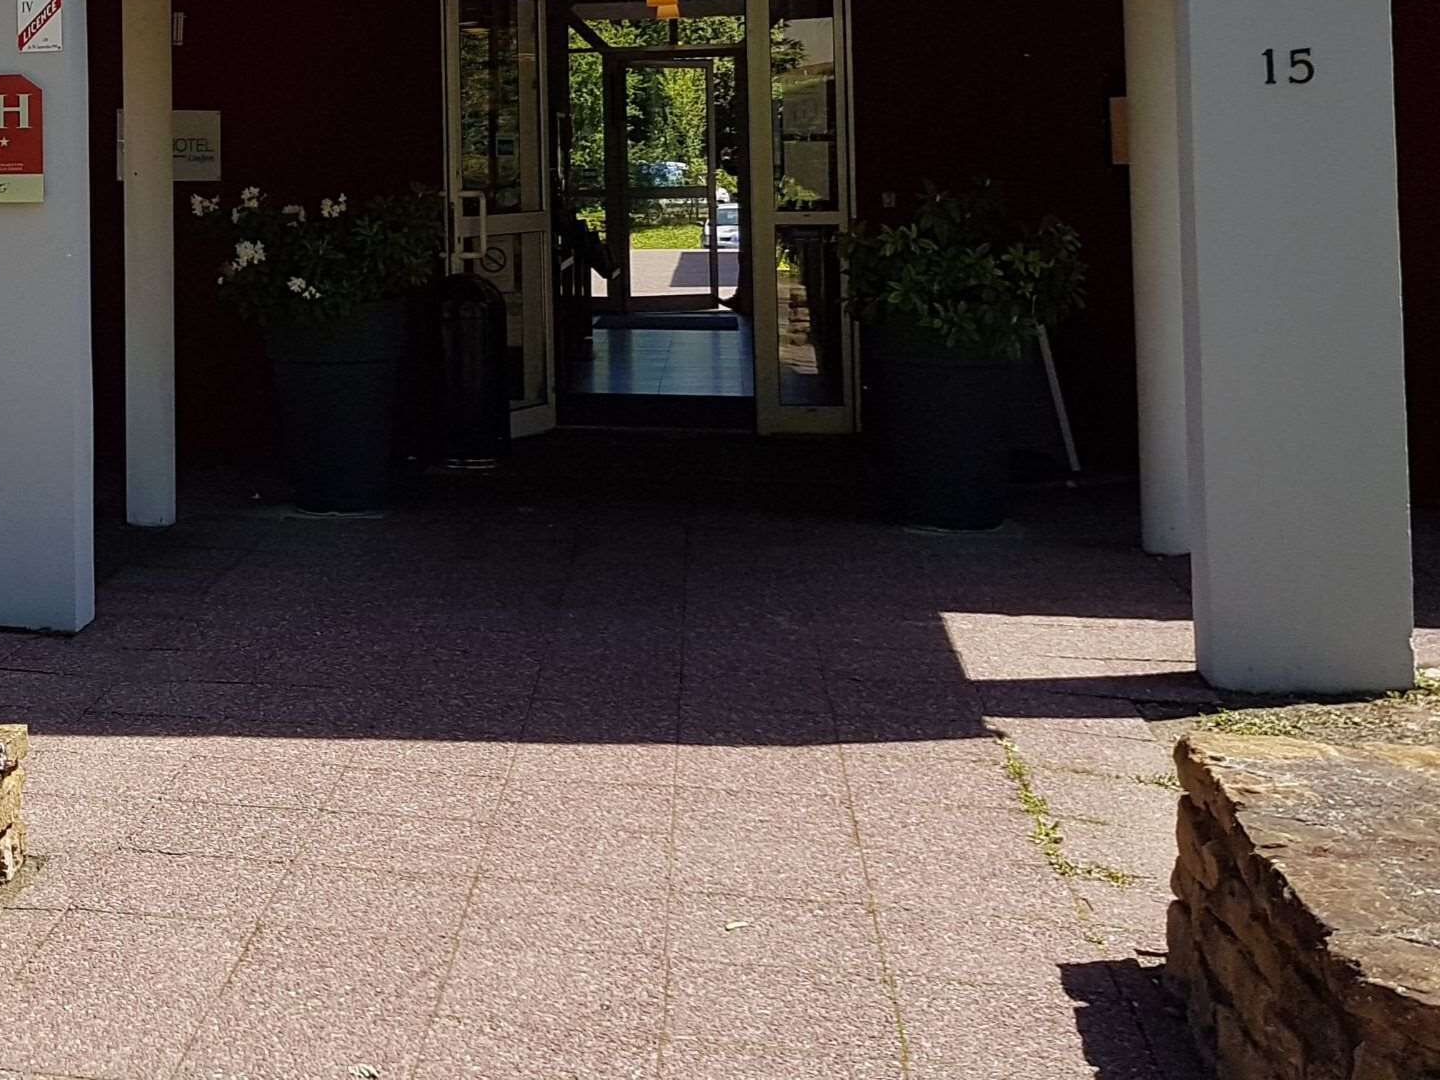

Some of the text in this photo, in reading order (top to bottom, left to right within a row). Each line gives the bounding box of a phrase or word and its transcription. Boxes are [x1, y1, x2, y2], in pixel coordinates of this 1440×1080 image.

[22, 1, 34, 13] IV
[1261, 47, 1315, 85] 15
[173, 137, 214, 153] OTEL
